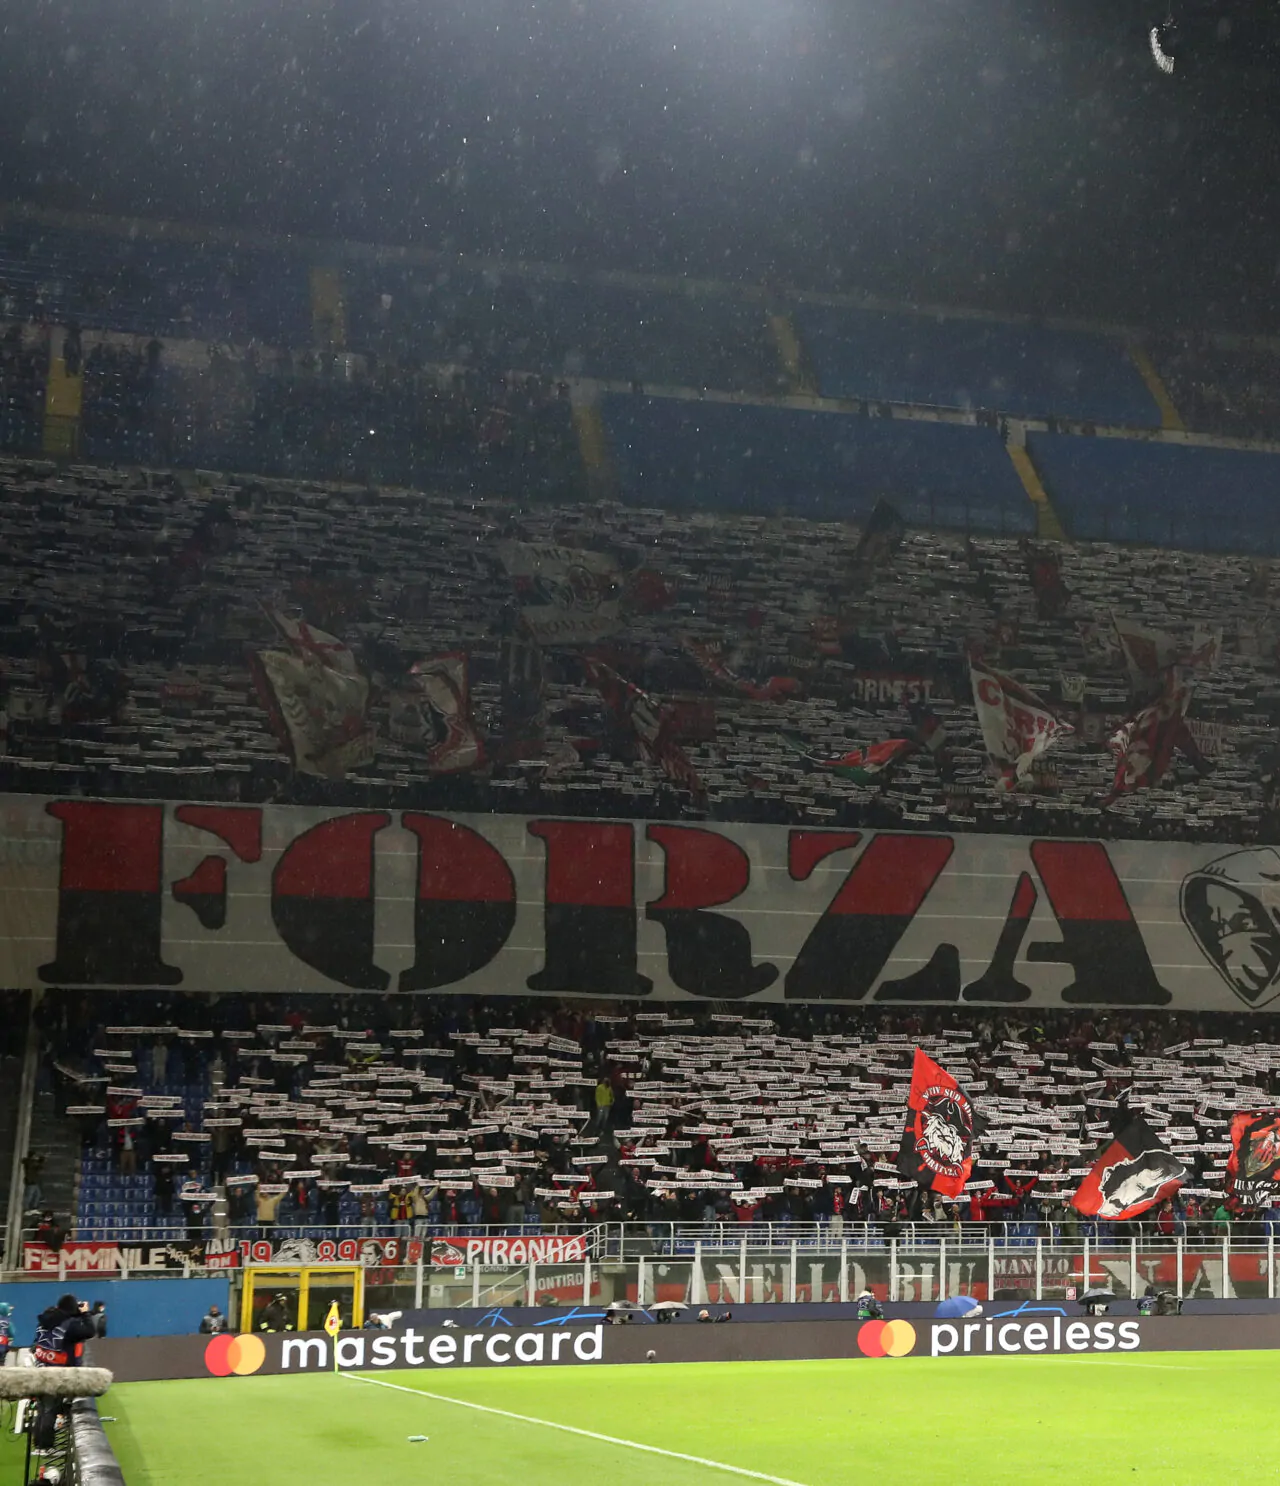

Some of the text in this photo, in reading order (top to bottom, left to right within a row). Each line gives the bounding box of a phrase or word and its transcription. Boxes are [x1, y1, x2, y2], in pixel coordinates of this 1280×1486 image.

[37, 800, 1172, 1005] FORZA
[317, 1240, 357, 1263] 89
[466, 1238, 586, 1265] PIRANHA
[281, 1324, 603, 1369] mastercard
[931, 1317, 1140, 1357] priceless
